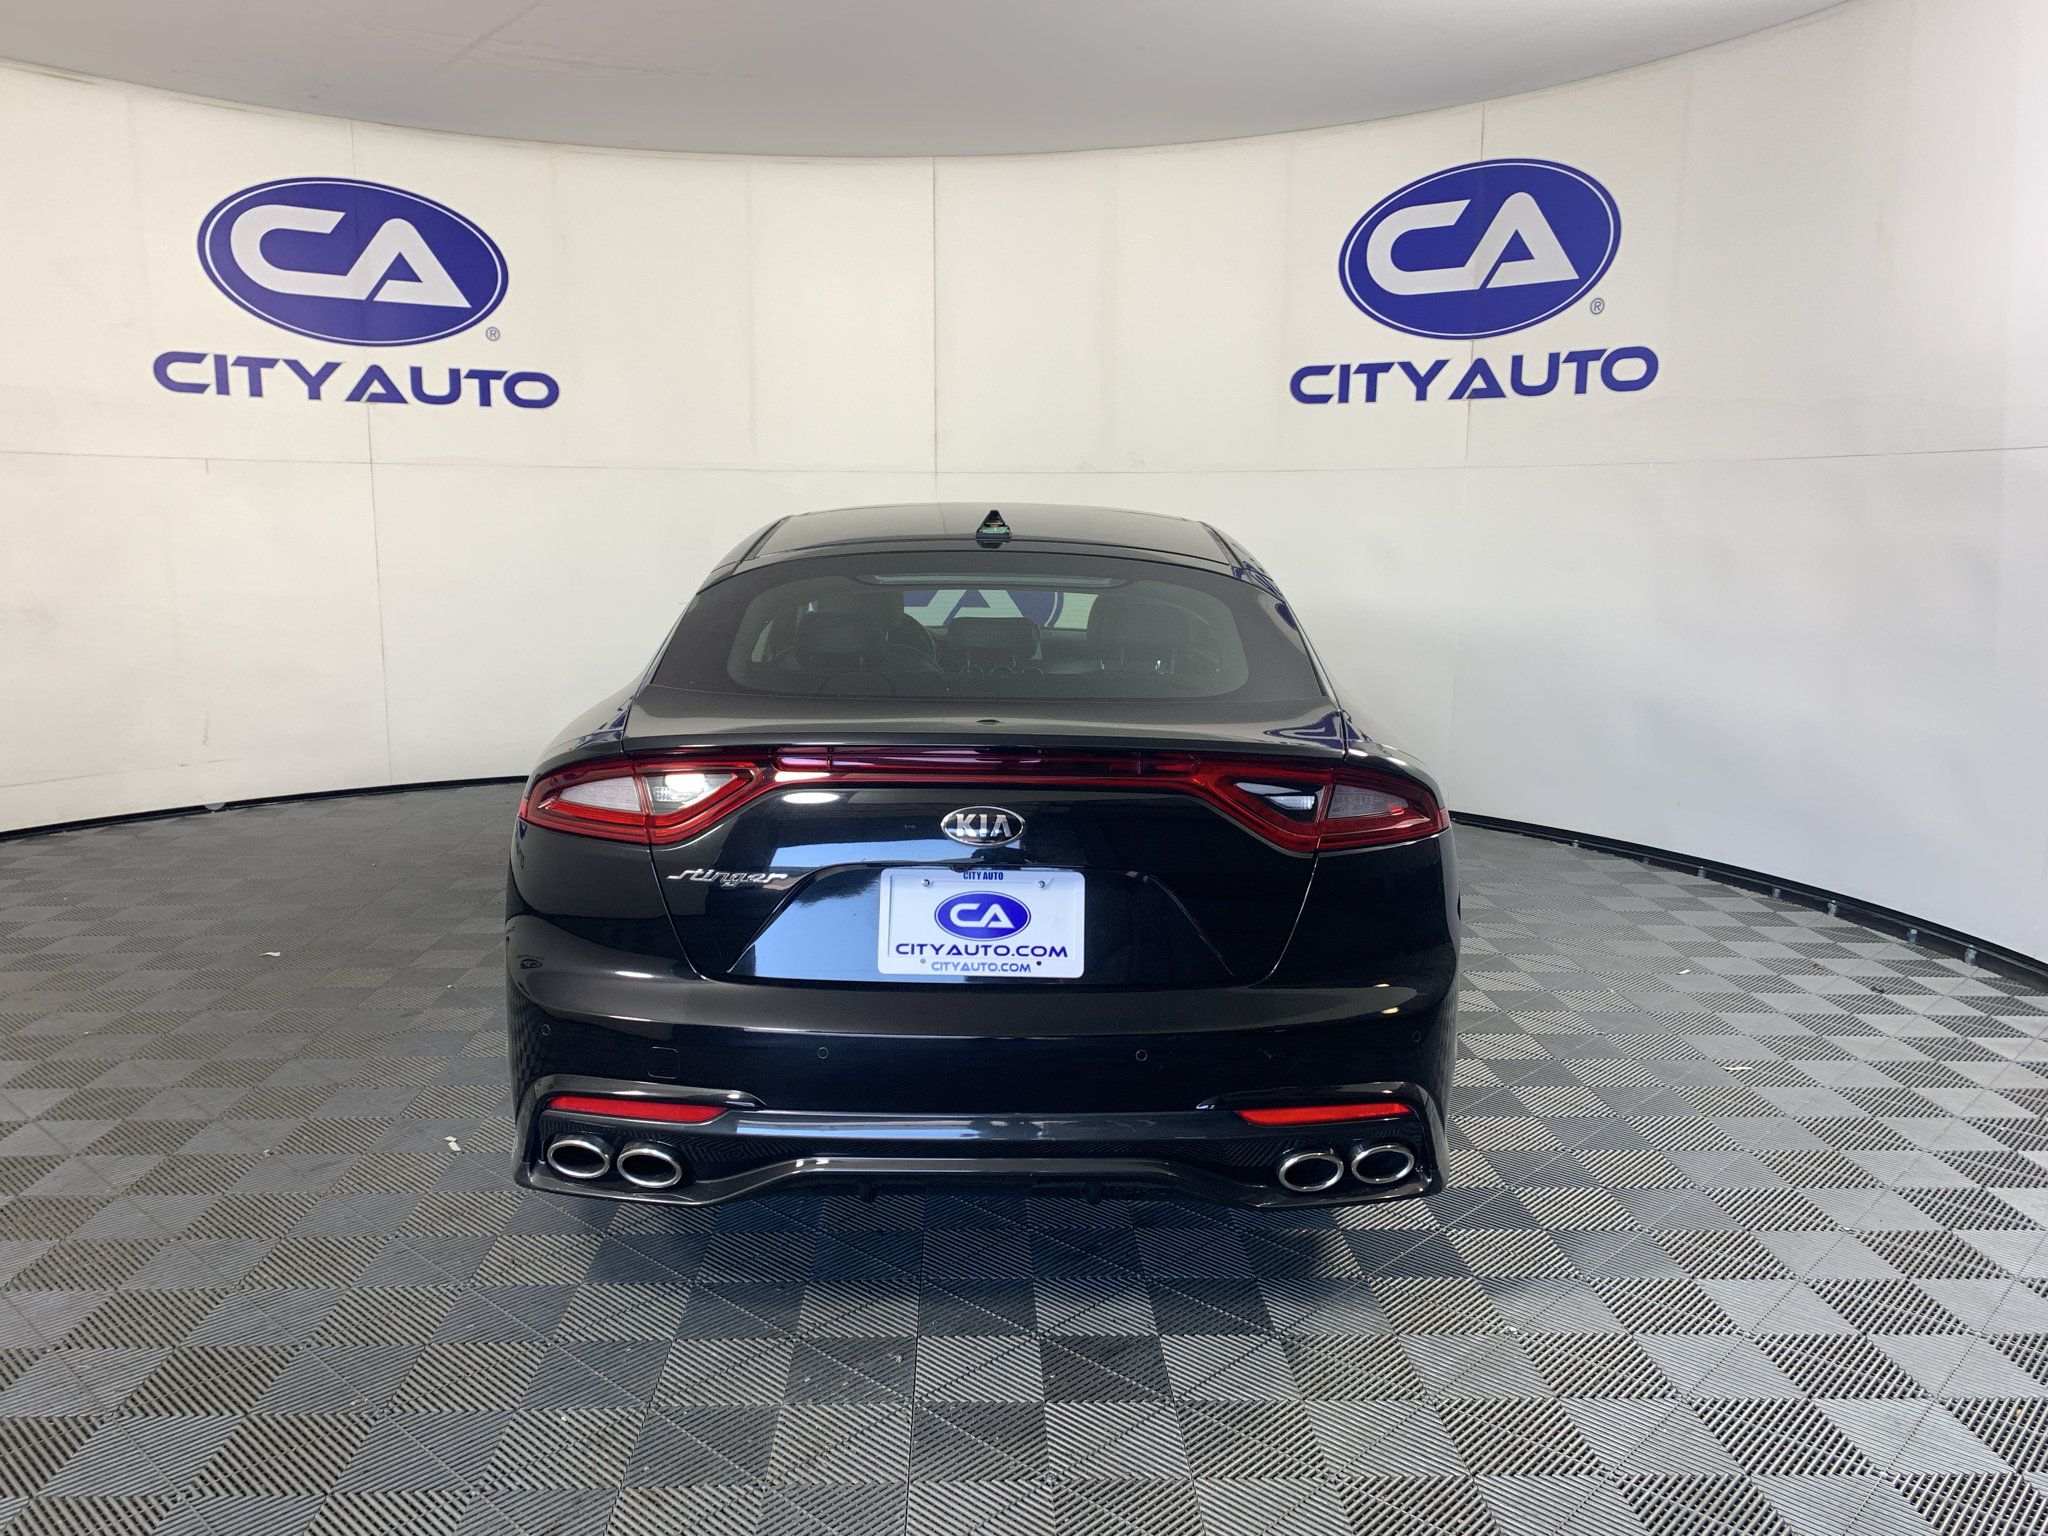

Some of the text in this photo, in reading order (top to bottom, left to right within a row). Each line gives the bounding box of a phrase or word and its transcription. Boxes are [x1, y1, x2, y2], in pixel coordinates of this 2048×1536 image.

[230, 204, 472, 309] CA
[1366, 191, 1580, 296] CA
[152, 351, 560, 409] CITY AUTO
[1289, 345, 1659, 405] CITY AUTO
[955, 813, 1013, 837] KIA
[963, 871, 1004, 881] CITY AUTO
[949, 902, 1016, 929] CA
[895, 943, 1068, 958] CITYAUTO.COM
[931, 961, 1031, 973] CITYAUTO.COM
